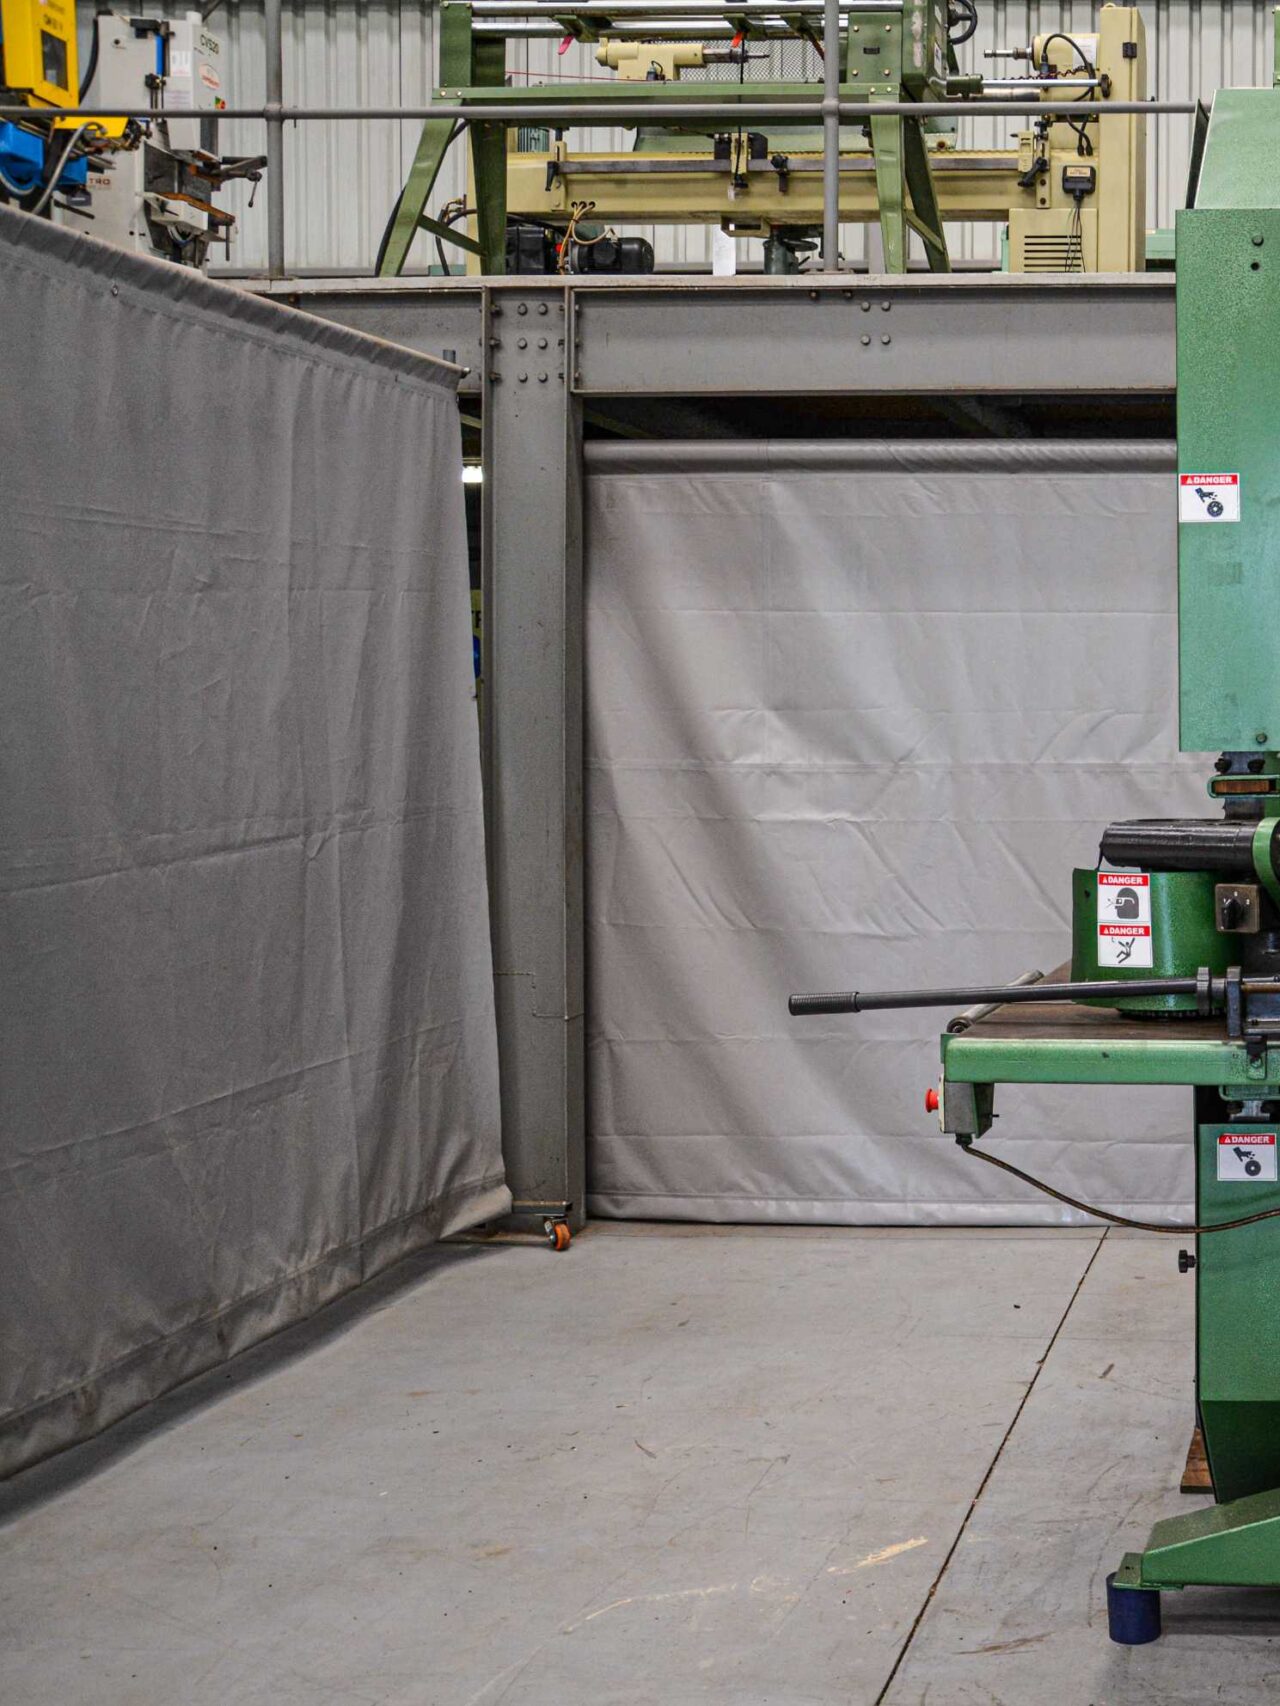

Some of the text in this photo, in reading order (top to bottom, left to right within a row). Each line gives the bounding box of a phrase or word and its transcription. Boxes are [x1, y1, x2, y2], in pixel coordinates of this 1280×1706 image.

[1193, 475, 1233, 484] DANGER
[1107, 876, 1143, 885] DANGER
[1108, 927, 1145, 935] DANGER
[1231, 1136, 1270, 1144] DANGER
